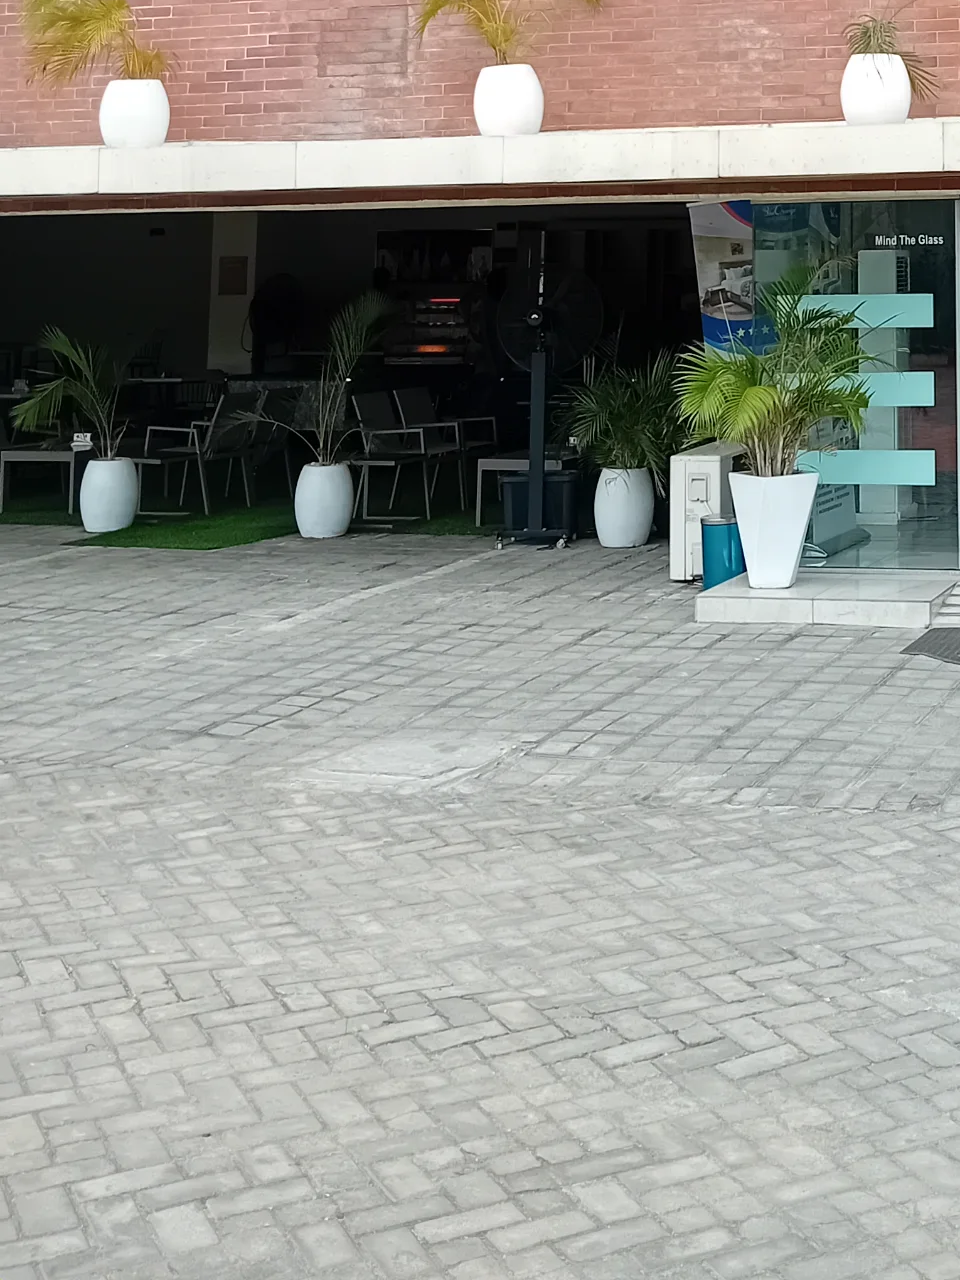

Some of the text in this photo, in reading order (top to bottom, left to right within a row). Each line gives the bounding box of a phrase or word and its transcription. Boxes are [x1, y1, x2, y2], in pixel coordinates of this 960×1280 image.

[875, 234, 944, 246] Mind The Glass
